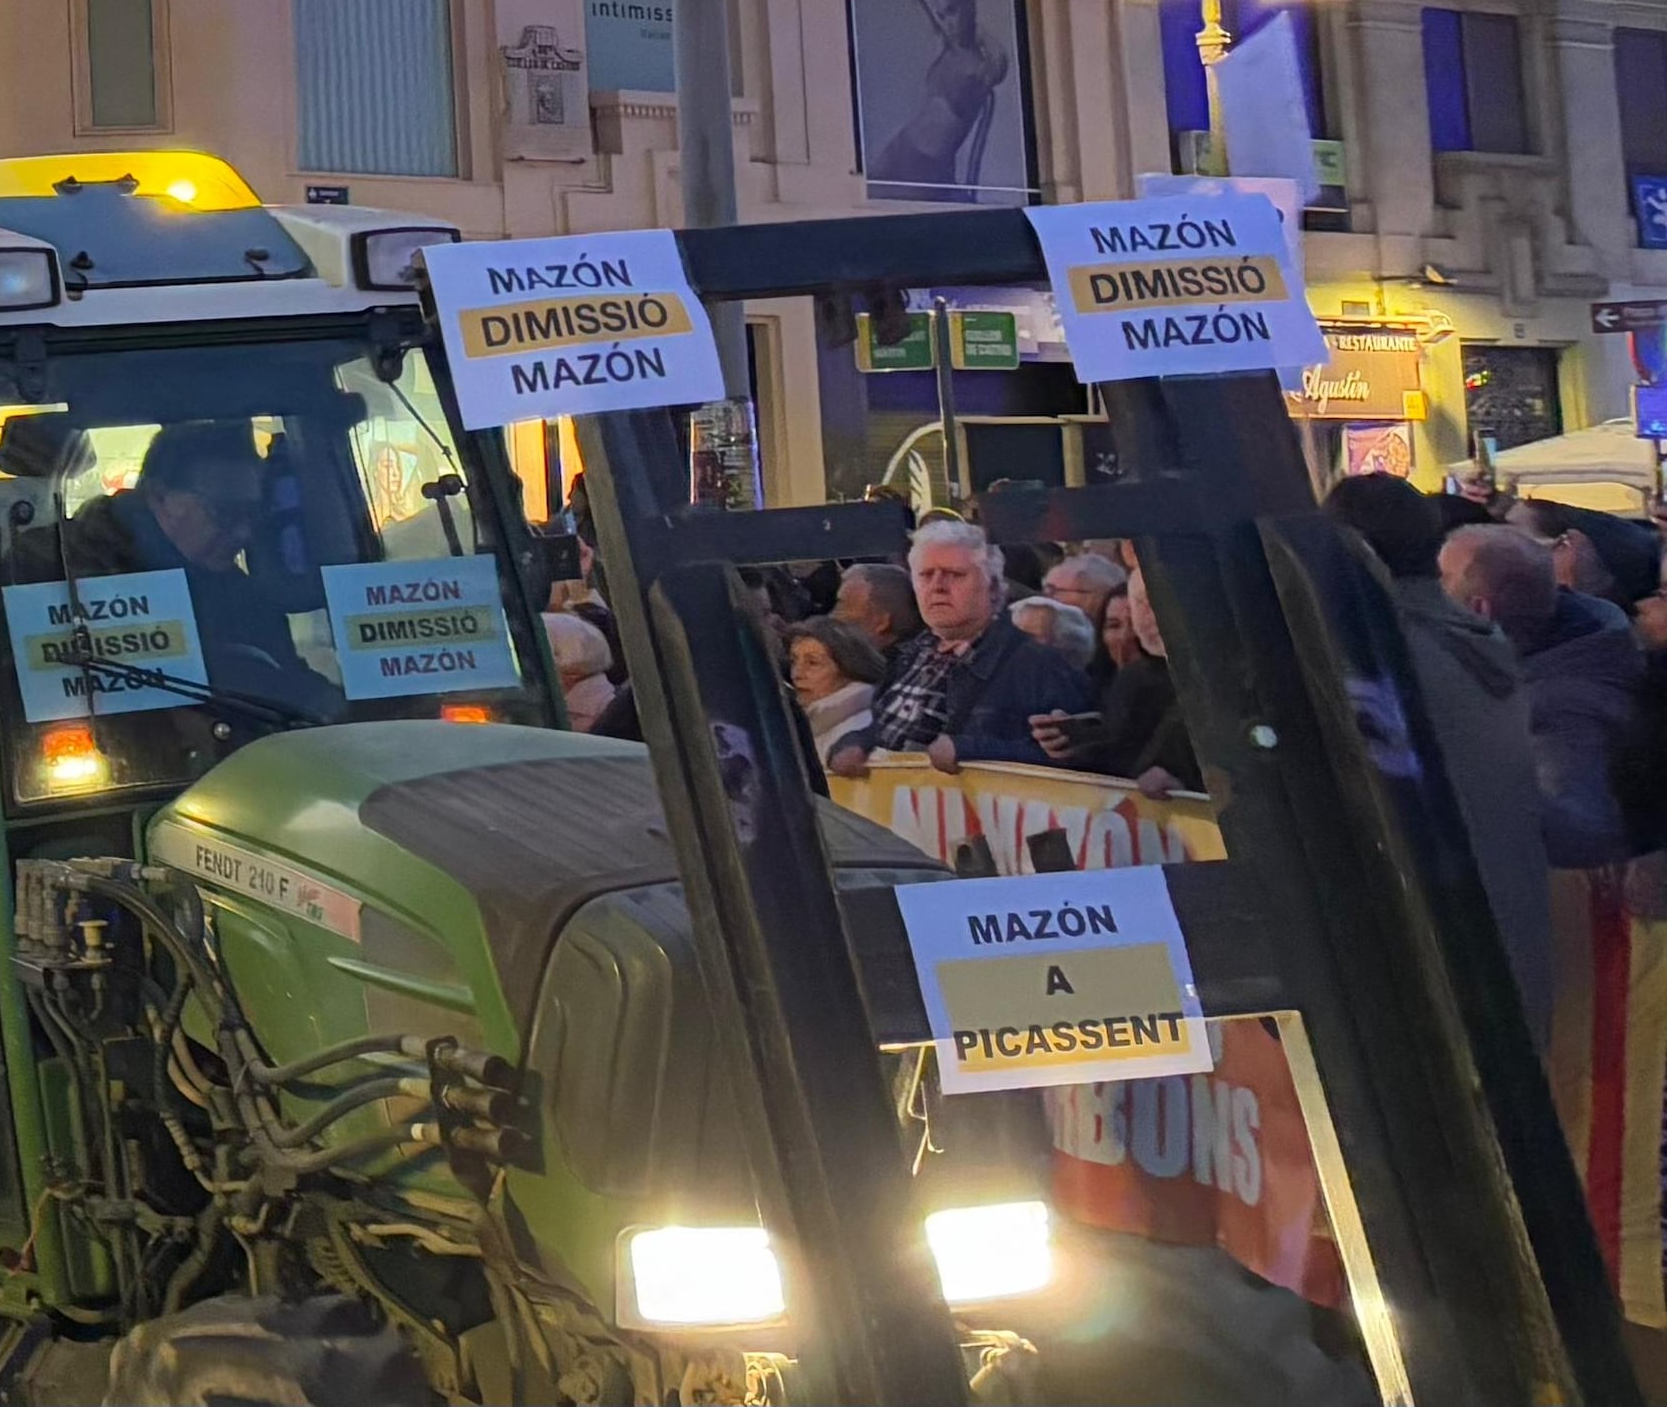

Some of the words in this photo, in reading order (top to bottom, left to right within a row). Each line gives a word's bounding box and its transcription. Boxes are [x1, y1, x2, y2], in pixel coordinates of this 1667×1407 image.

[1090, 213, 1237, 253] MAZÓN
[487, 253, 633, 294] MAZÓN
[1090, 256, 1266, 304] DIMISSIÓ
[481, 293, 668, 347] DIMISSIÓ
[1121, 305, 1271, 350] MAZÓN
[1337, 334, 1418, 352] RESTAURANTE
[511, 342, 665, 394] MAZÓN
[48, 594, 149, 625] MAZÓN
[366, 578, 462, 606] MAZÓN
[41, 626, 170, 663] DIISSIÓ
[359, 610, 478, 643] DIMISSIÓ
[380, 648, 476, 676] MAZÓN
[196, 844, 241, 883] FENDT
[248, 866, 274, 895] 210
[280, 877, 289, 901] F
[968, 900, 1118, 945] MAZÓN
[1046, 965, 1075, 995] A
[953, 1012, 1185, 1061] PICASSENT
